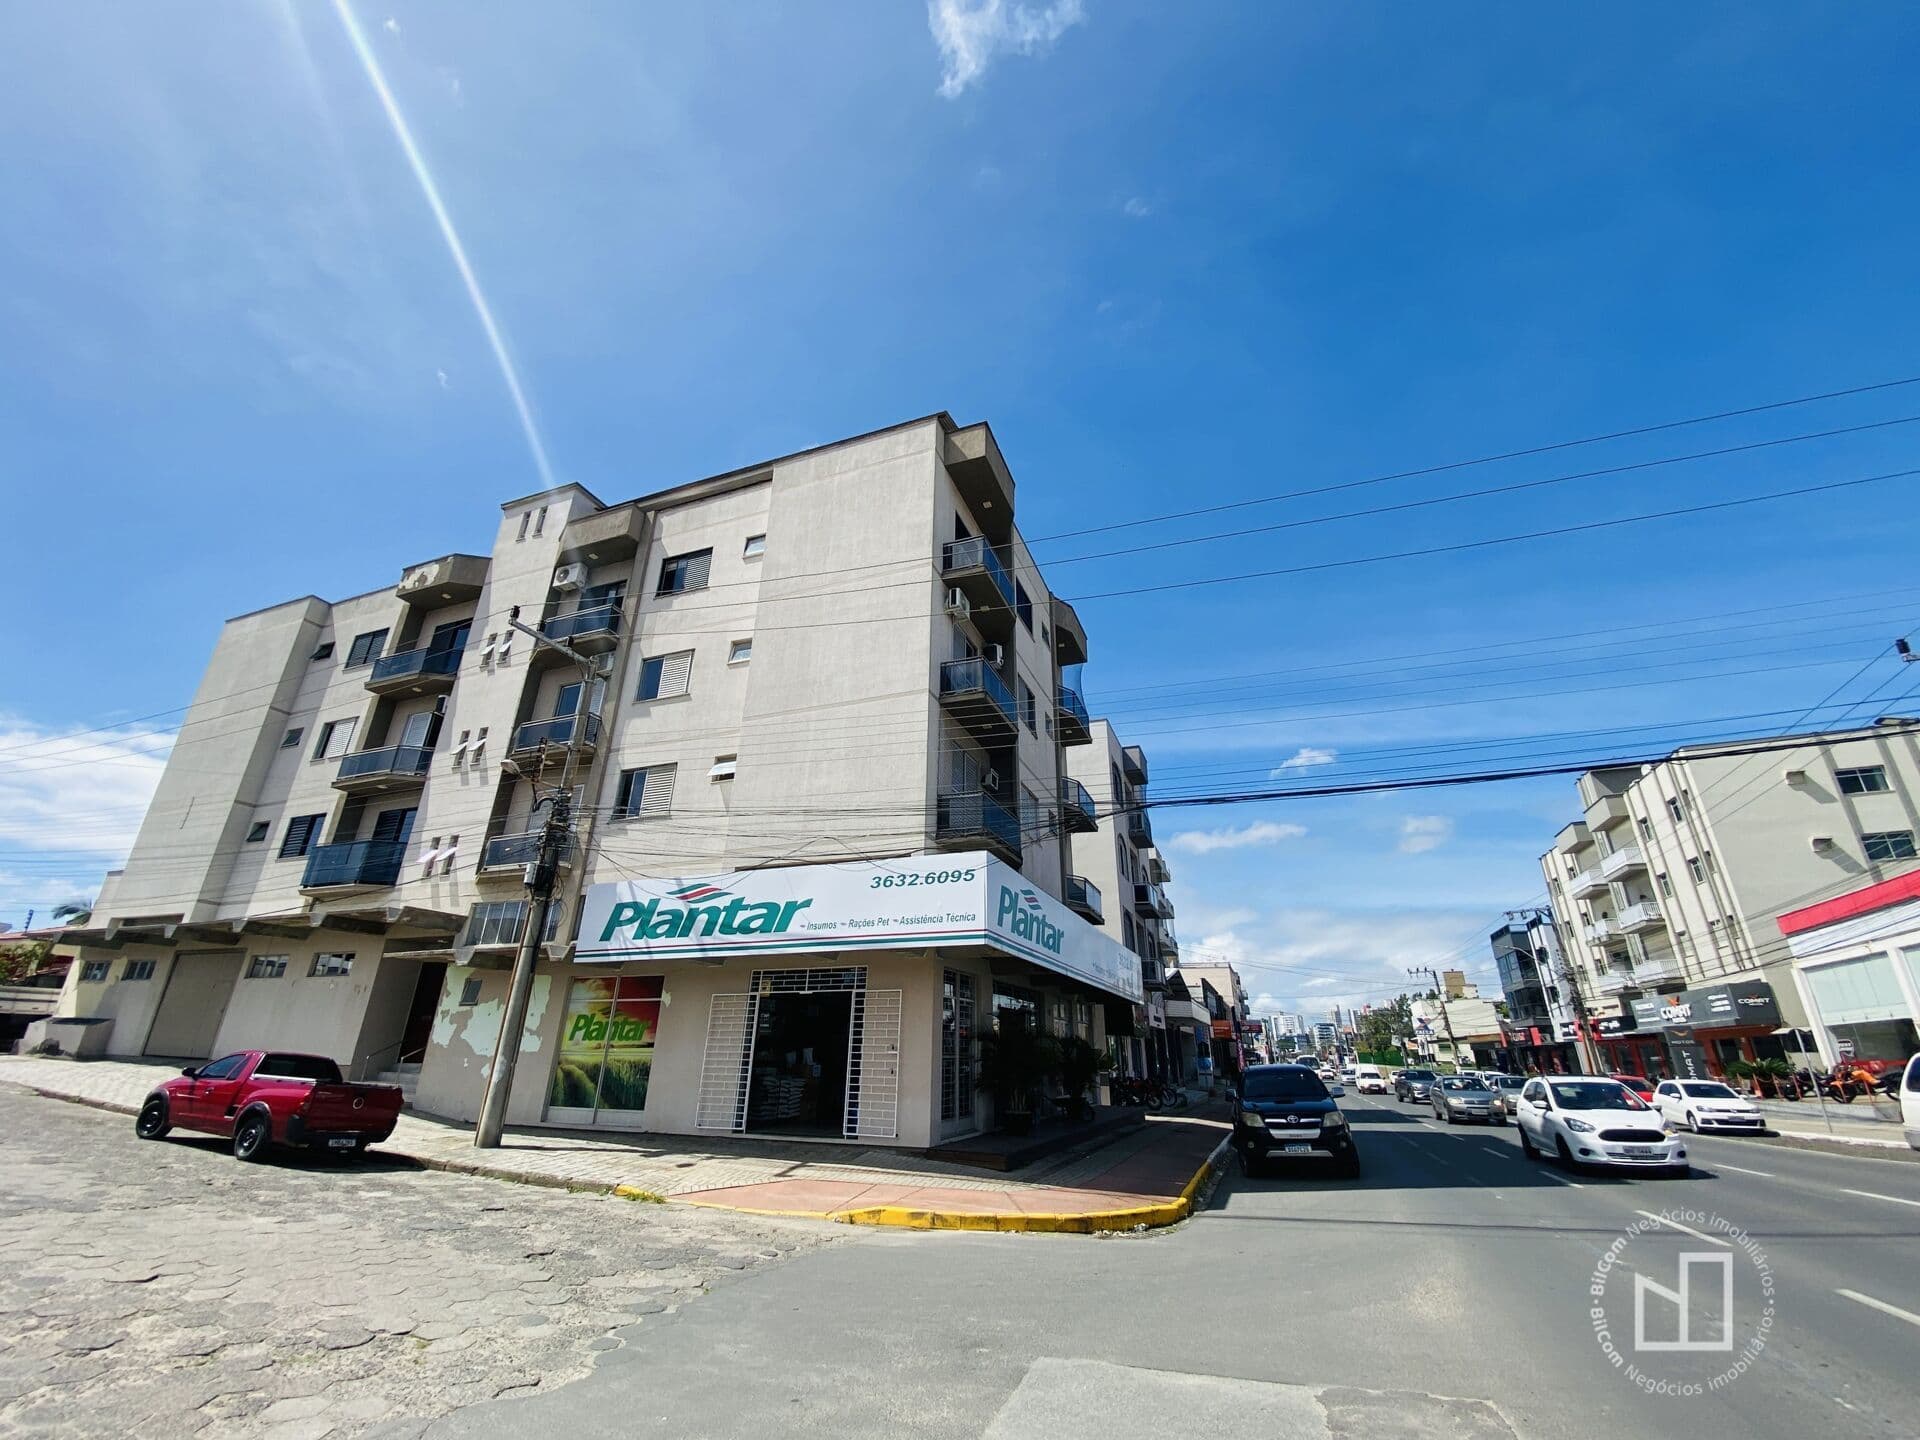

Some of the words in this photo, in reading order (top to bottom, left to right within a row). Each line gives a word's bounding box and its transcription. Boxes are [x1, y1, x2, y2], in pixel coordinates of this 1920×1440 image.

[870, 869, 976, 889] 3632.6095
[599, 896, 814, 942] Plantar
[807, 920, 837, 931] Insumos
[848, 918, 875, 929] Rações
[876, 917, 890, 927] Pet
[899, 913, 944, 925] Assistência
[946, 911, 976, 923] Técnica
[997, 884, 1065, 954] Plantar
[568, 1013, 650, 1041] Plantar
